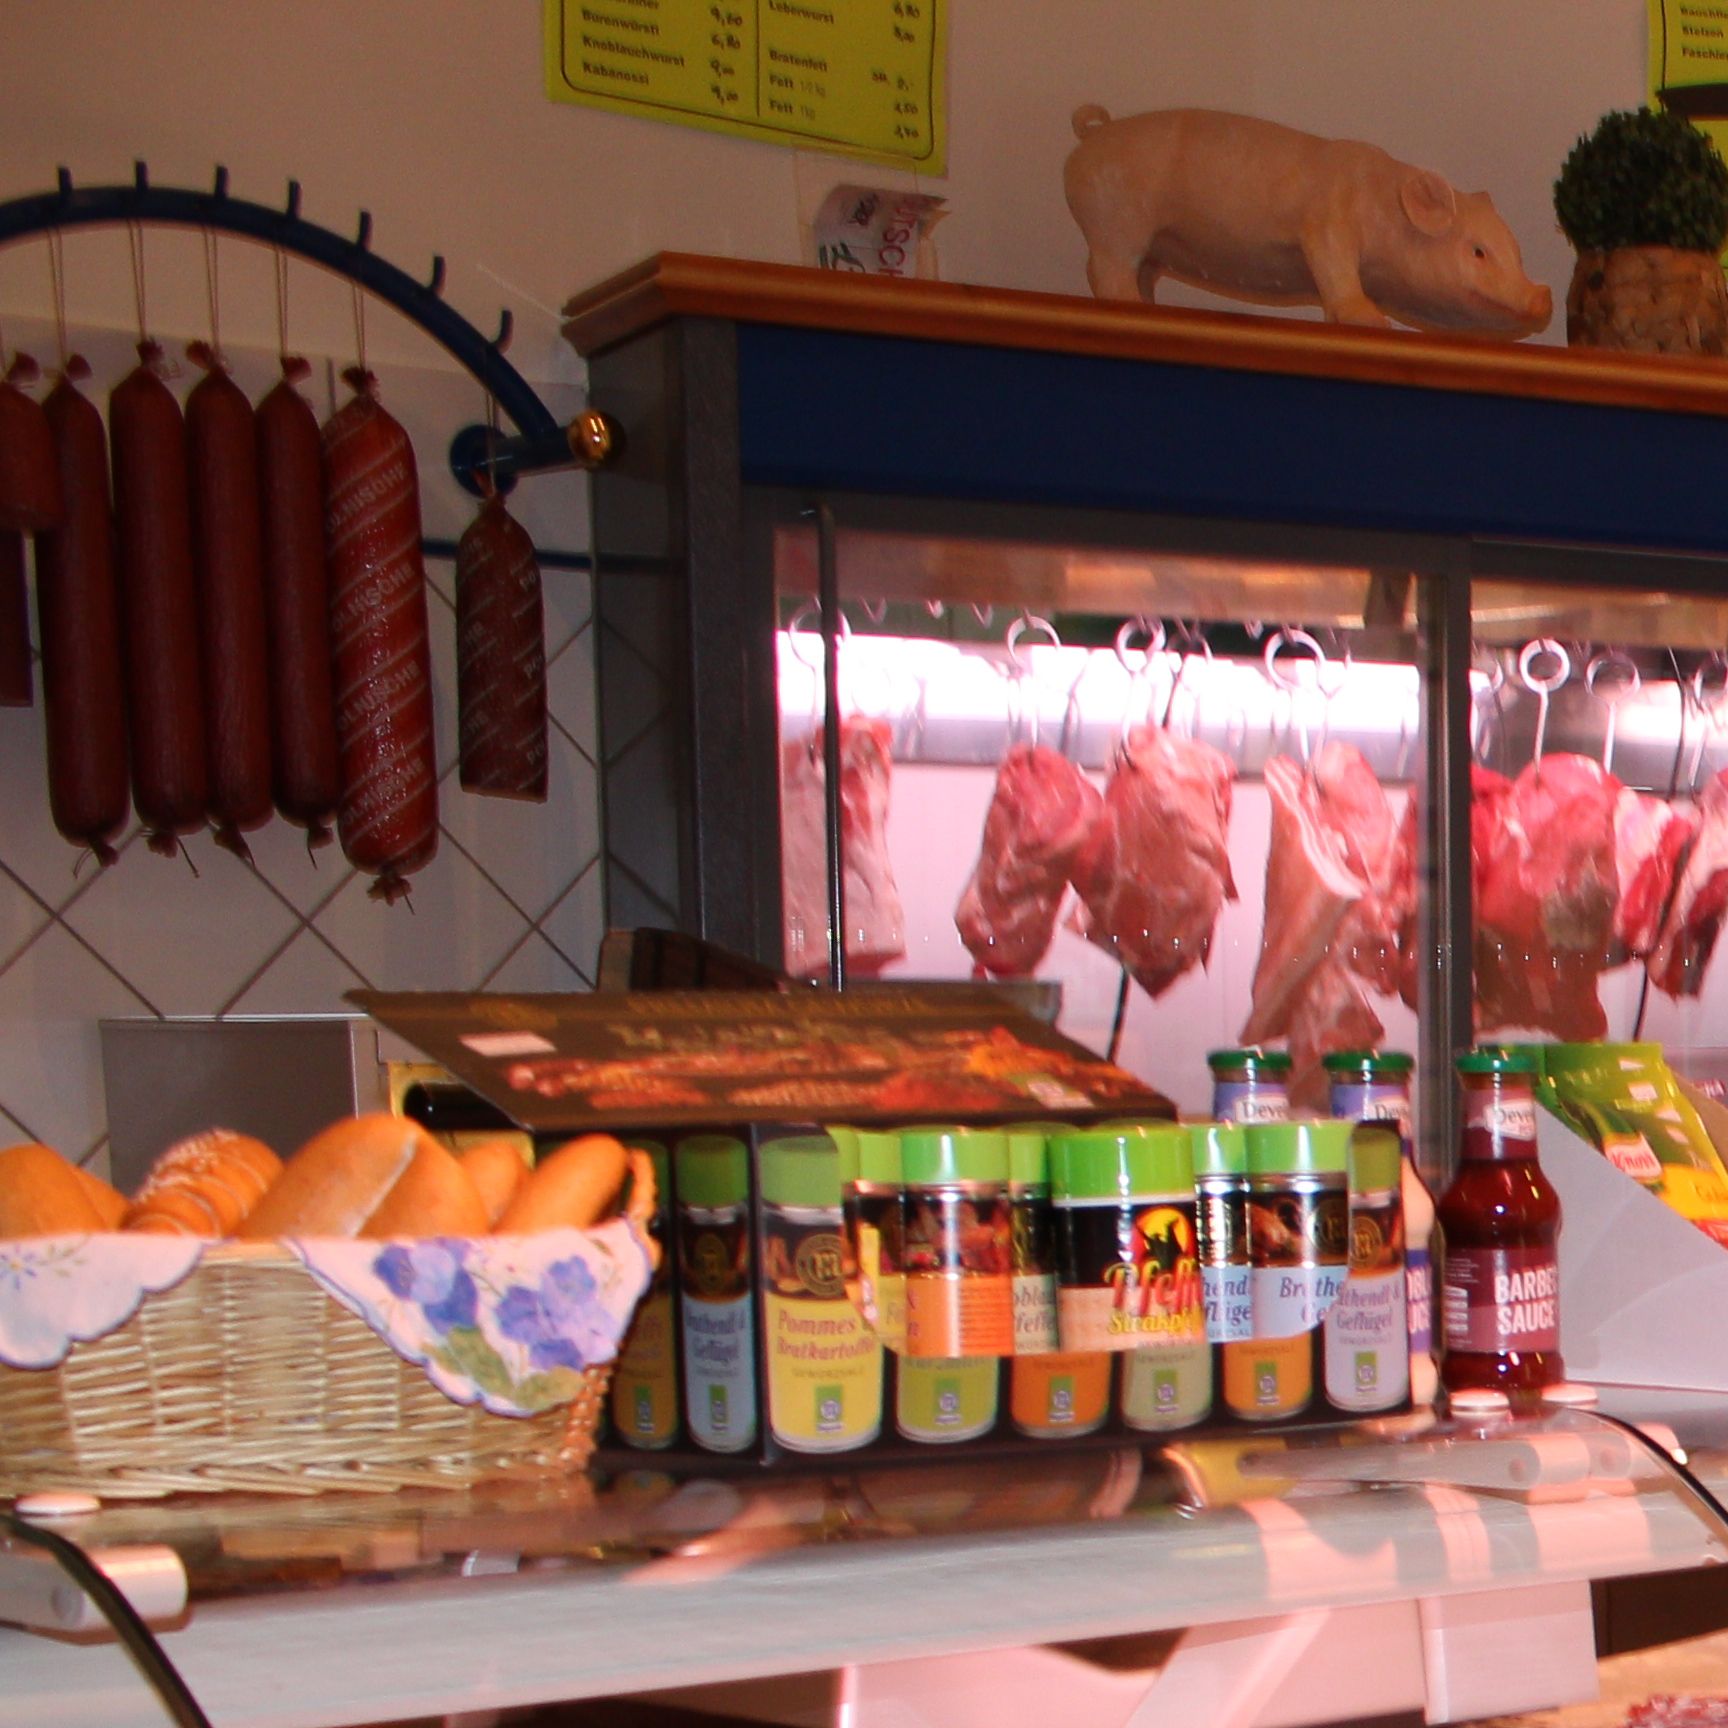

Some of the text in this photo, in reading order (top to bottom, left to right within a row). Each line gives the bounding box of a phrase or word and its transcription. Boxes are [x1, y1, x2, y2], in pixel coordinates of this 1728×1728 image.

[582, 34, 685, 67] Knoblauchwurst
[769, 48, 828, 73] Bratenfett
[582, 61, 650, 86] Kabanossi
[769, 73, 794, 90] Fett
[769, 98, 794, 114] Fett
[1496, 1299, 1555, 1336] SAUCE
